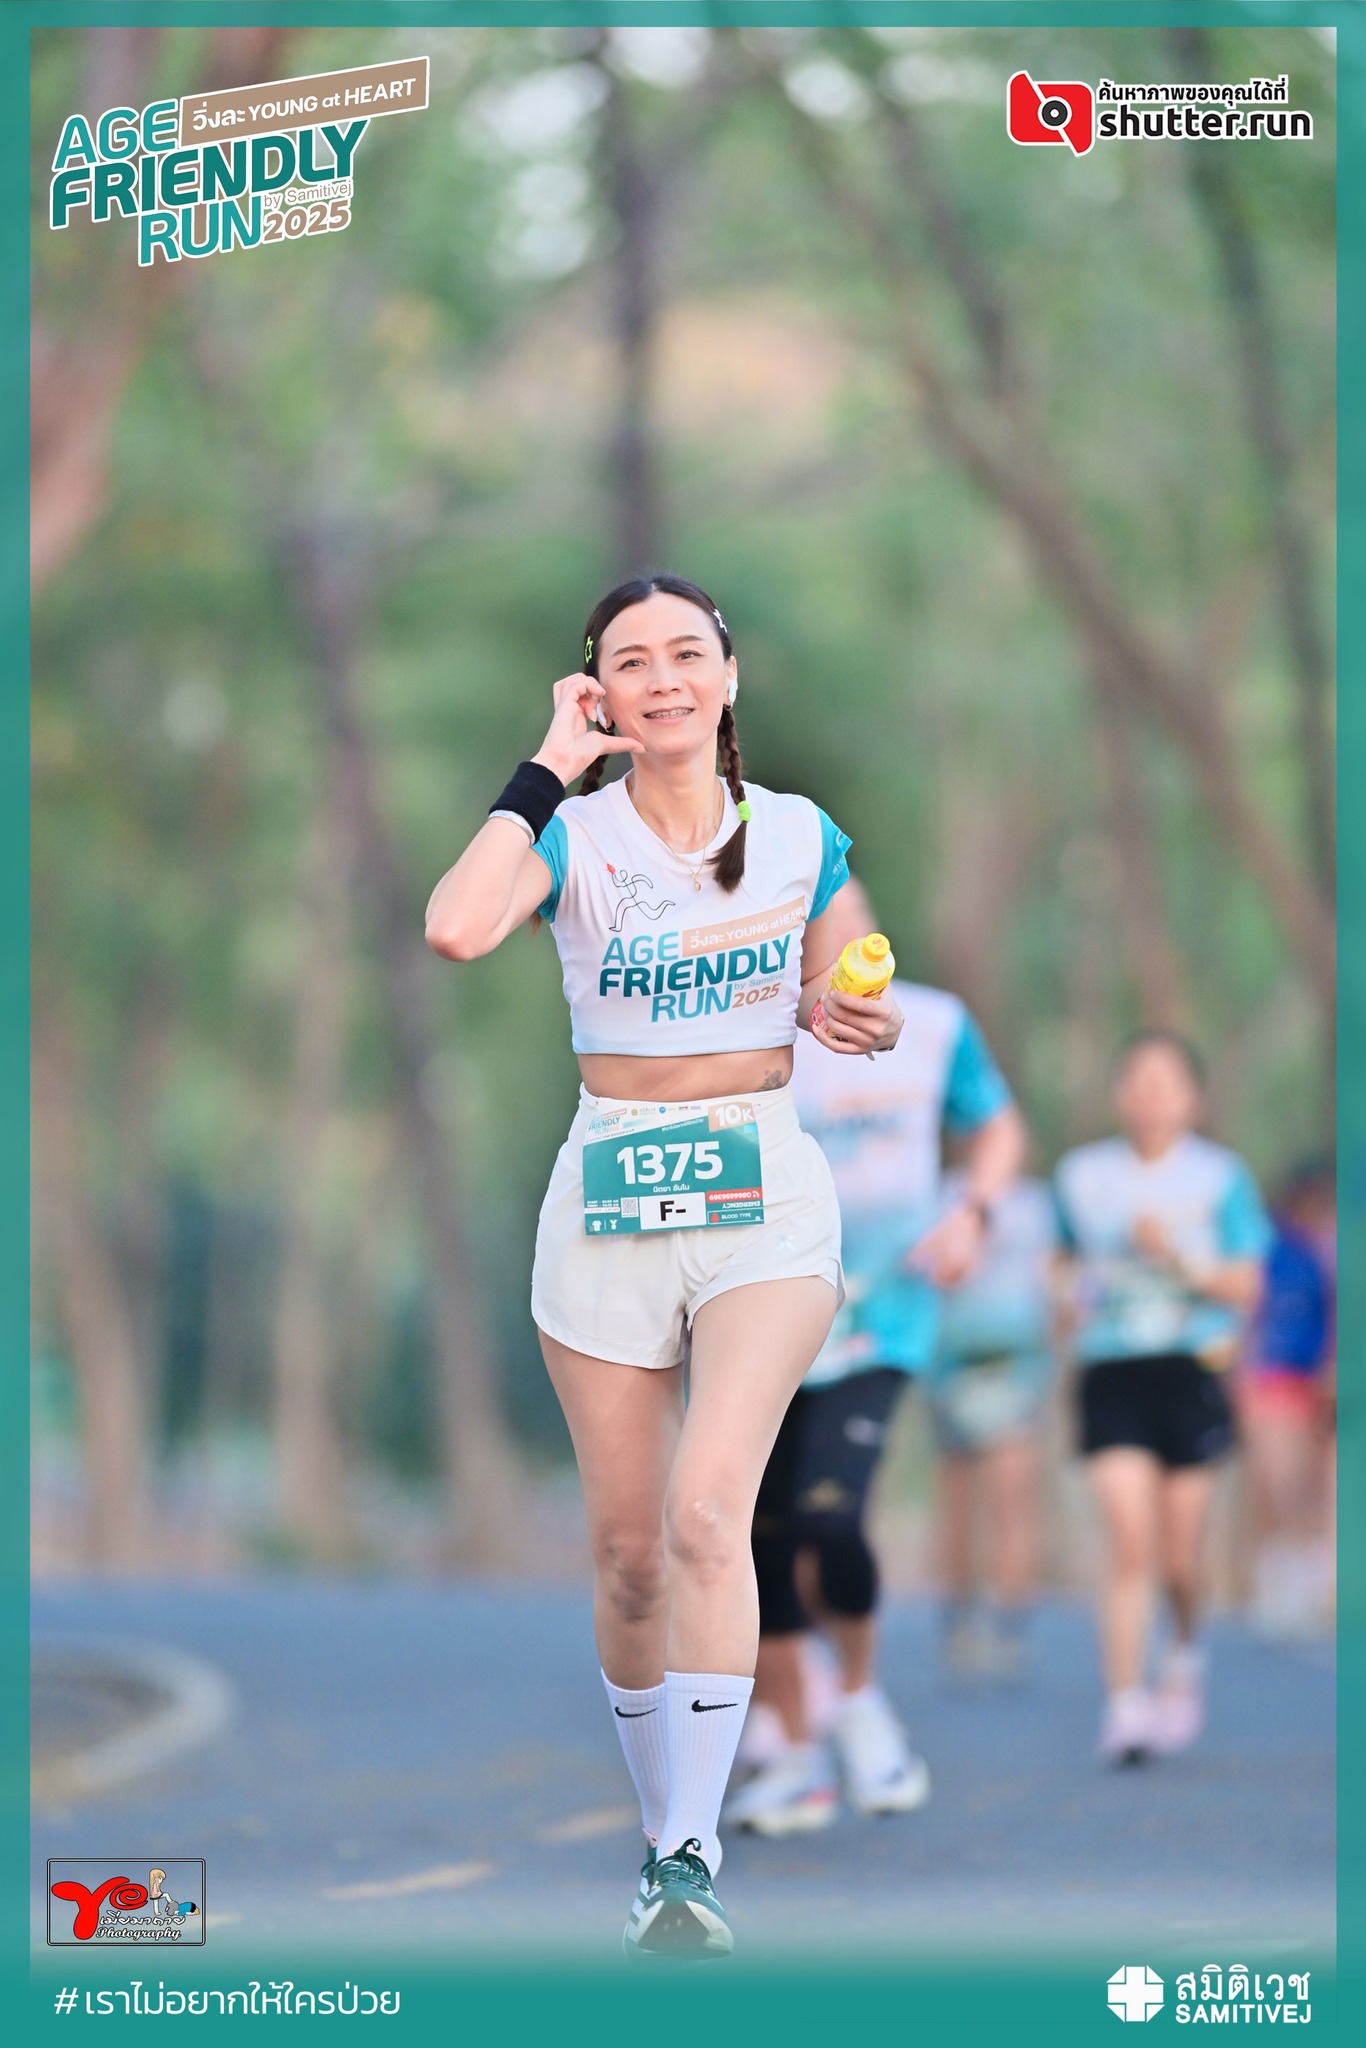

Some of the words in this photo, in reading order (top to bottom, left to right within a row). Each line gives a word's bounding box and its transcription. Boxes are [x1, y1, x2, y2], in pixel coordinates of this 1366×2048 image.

[726, 922, 769, 941] YOUNG
[770, 919, 779, 929] at
[601, 931, 679, 967] AGE
[600, 933, 791, 998] FRIENDLY
[732, 982, 781, 1009] 2025
[734, 982, 746, 991] by
[651, 983, 733, 1023] RUN
[616, 1140, 724, 1185] 1375
[660, 1200, 686, 1221] F-
[722, 1200, 761, 1209] EMERGENCY
